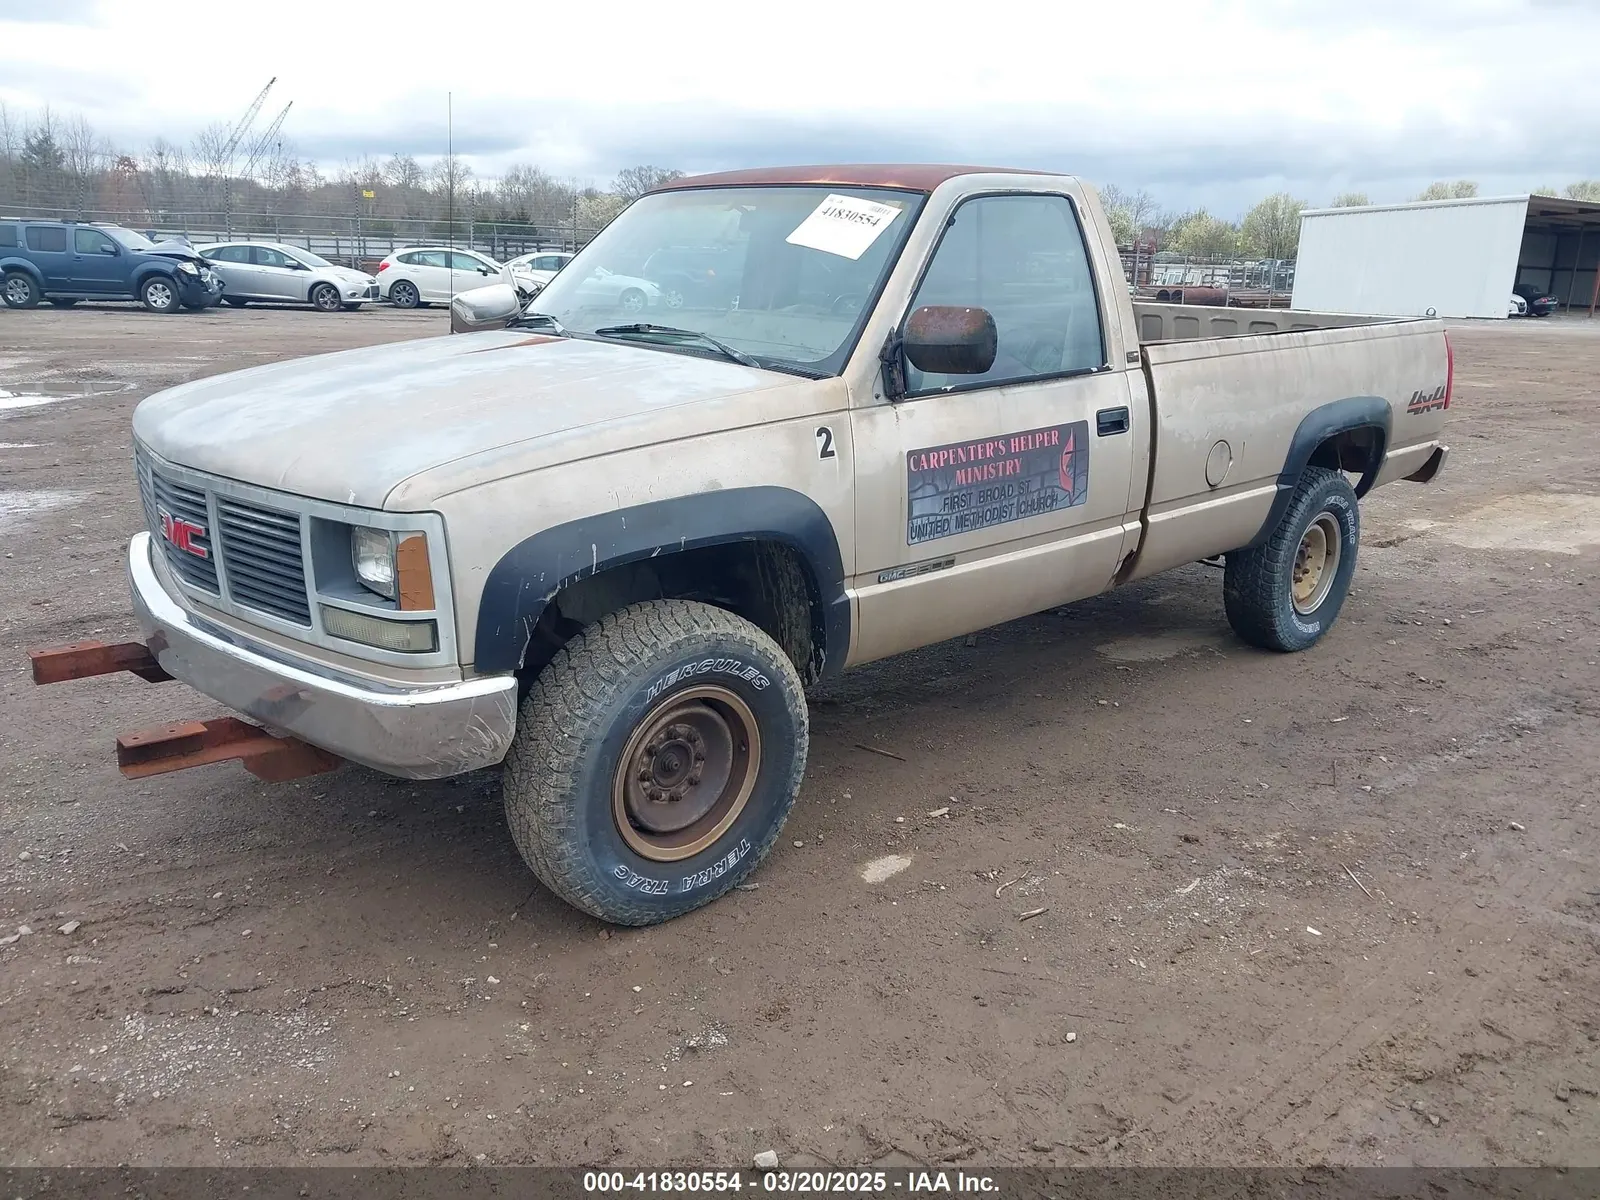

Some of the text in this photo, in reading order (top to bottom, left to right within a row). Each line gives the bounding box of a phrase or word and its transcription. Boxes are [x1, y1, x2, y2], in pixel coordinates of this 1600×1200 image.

[822, 206, 881, 227] 41830554
[1407, 385, 1445, 415] 4x4
[816, 427, 835, 458] 2
[910, 430, 1060, 472] CARPENTER'S HELPER
[955, 457, 1023, 486] MINISTRY
[942, 491, 973, 513] FIRST
[978, 486, 1015, 505] BROAD
[910, 492, 1058, 540] UNITED METHODIST CHURCH
[880, 570, 904, 583] GMC
[646, 658, 771, 703] HERCULES
[613, 838, 751, 895] TERRA TRAC
